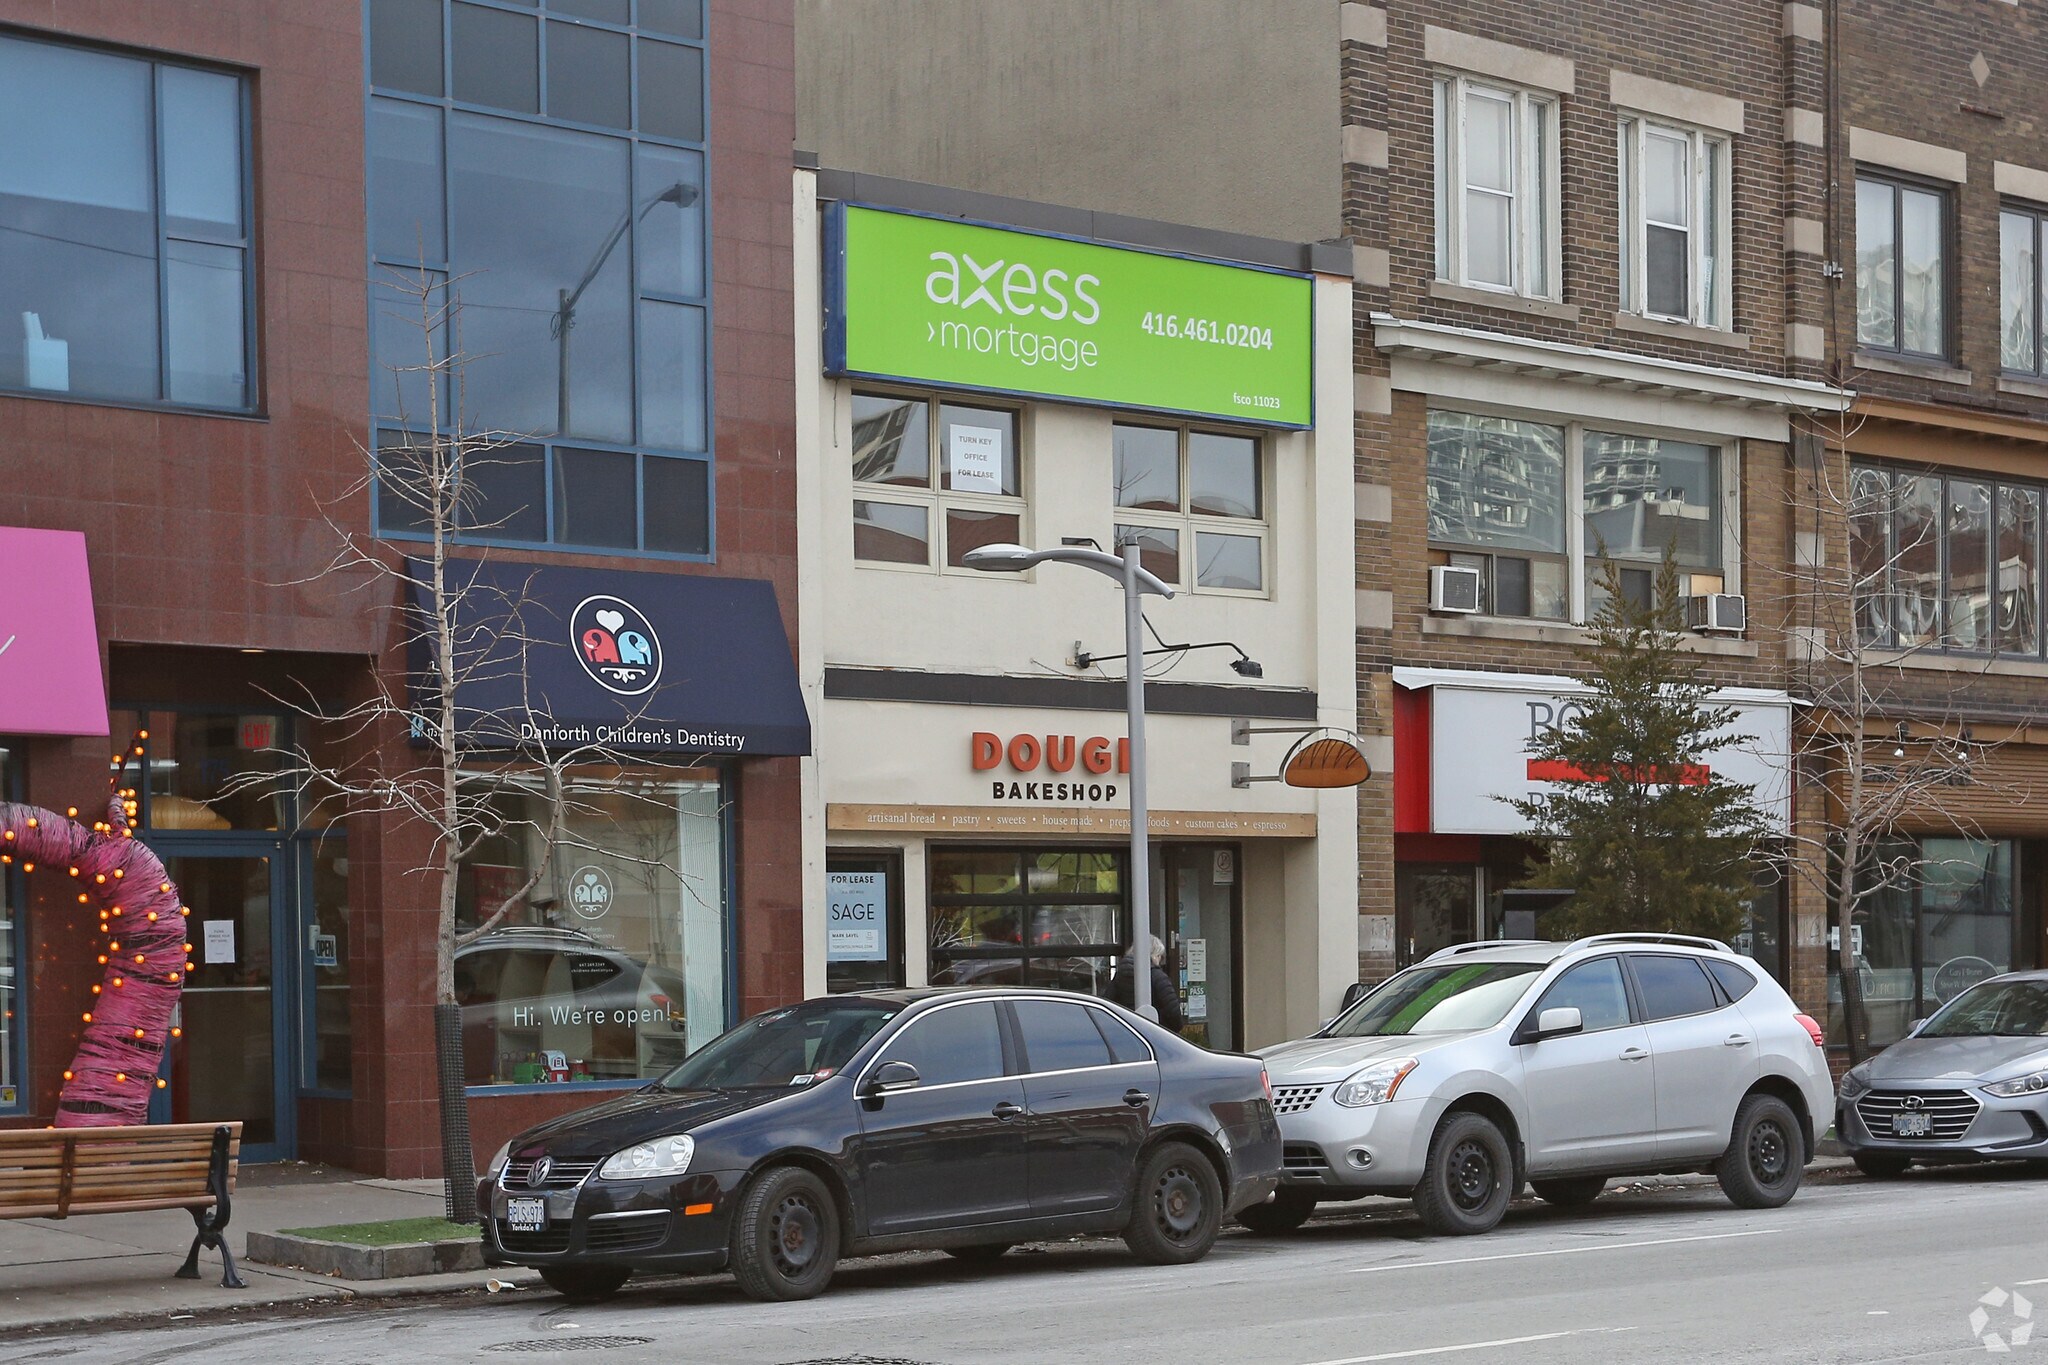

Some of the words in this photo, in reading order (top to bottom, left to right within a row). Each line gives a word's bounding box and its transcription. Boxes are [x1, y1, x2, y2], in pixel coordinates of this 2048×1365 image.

[925, 251, 1100, 325] axess
[1141, 311, 1273, 351] 416.461.0204
[941, 321, 1098, 371] mortgage
[1233, 392, 1251, 405] fsco
[1254, 396, 1280, 409] 11023
[959, 436, 977, 444] TURN
[964, 453, 988, 461] OFFICE
[958, 469, 971, 477] FOR
[973, 470, 994, 479] LEASE
[244, 723, 271, 748] EXIT
[521, 723, 590, 742] Danforth
[596, 726, 671, 745] Children's
[677, 728, 746, 750] Dentistry
[993, 782, 1117, 801] BAKESHOP
[867, 812, 908, 824] artisanal
[910, 812, 936, 824] bread
[952, 814, 981, 827] pastry
[996, 815, 1027, 825] sweets
[1042, 815, 1068, 825] house
[1070, 816, 1093, 826] made
[1147, 817, 1170, 828] foods
[1185, 818, 1215, 829] custom
[1216, 818, 1239, 829] cakes
[1253, 820, 1287, 831] espresso
[832, 876, 847, 884] FOR
[849, 876, 874, 884] LEASE
[831, 903, 875, 921] SAGE
[317, 940, 334, 957] OPEN
[1190, 987, 1204, 996] PASS
[513, 1006, 542, 1027] Hi.
[550, 1004, 606, 1026] We're
[613, 1001, 671, 1028] open!
[512, 1223, 534, 1231] Yorkdale
